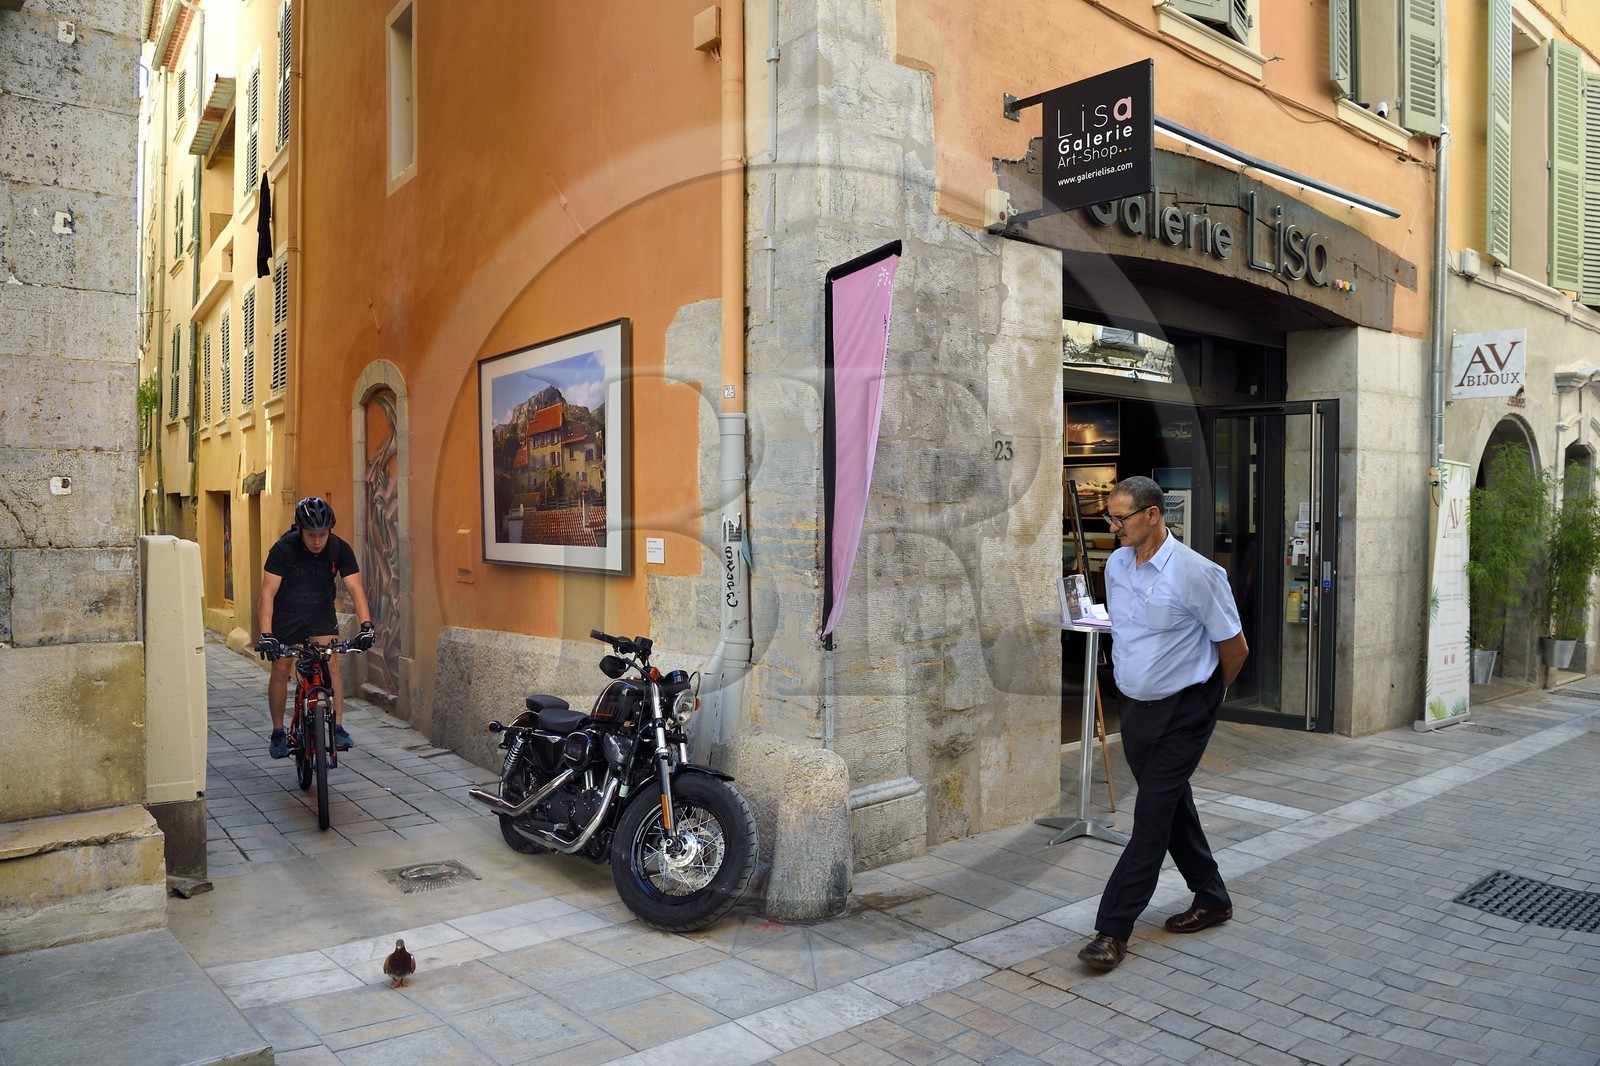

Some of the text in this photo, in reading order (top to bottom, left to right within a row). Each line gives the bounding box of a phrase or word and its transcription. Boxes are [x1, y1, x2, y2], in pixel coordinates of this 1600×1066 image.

[1057, 96, 1132, 139] Lisa
[1058, 125, 1133, 155] Galerie
[1057, 162, 1133, 186] www.galerielisa.com
[1454, 341, 1522, 387] AV
[1466, 371, 1520, 386] BIJOUX
[995, 440, 1013, 461] 23
